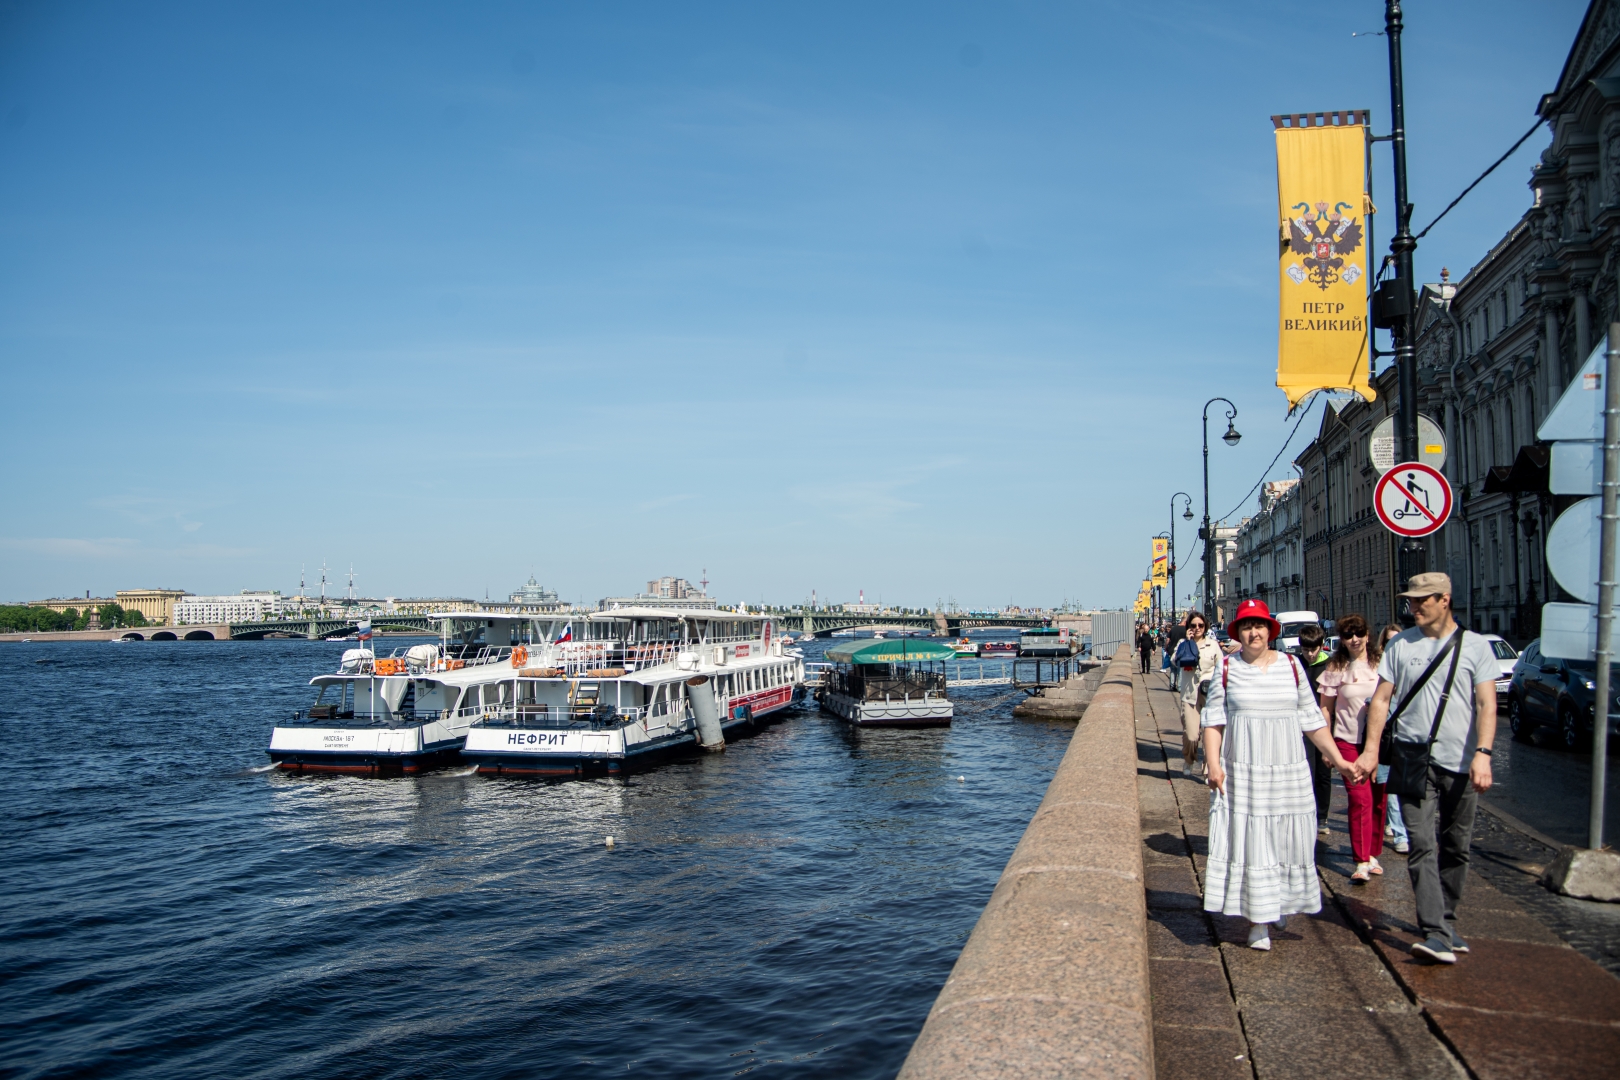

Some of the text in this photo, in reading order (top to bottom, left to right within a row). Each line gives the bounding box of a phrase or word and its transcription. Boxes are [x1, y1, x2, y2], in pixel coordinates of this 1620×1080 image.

[1303, 302, 1344, 314] ПЕТР
[1284, 315, 1362, 331] ВЕЛИКИЙ
[877, 653, 914, 661] ПРИЧАЛ
[507, 733, 568, 746] НЕФРИТ
